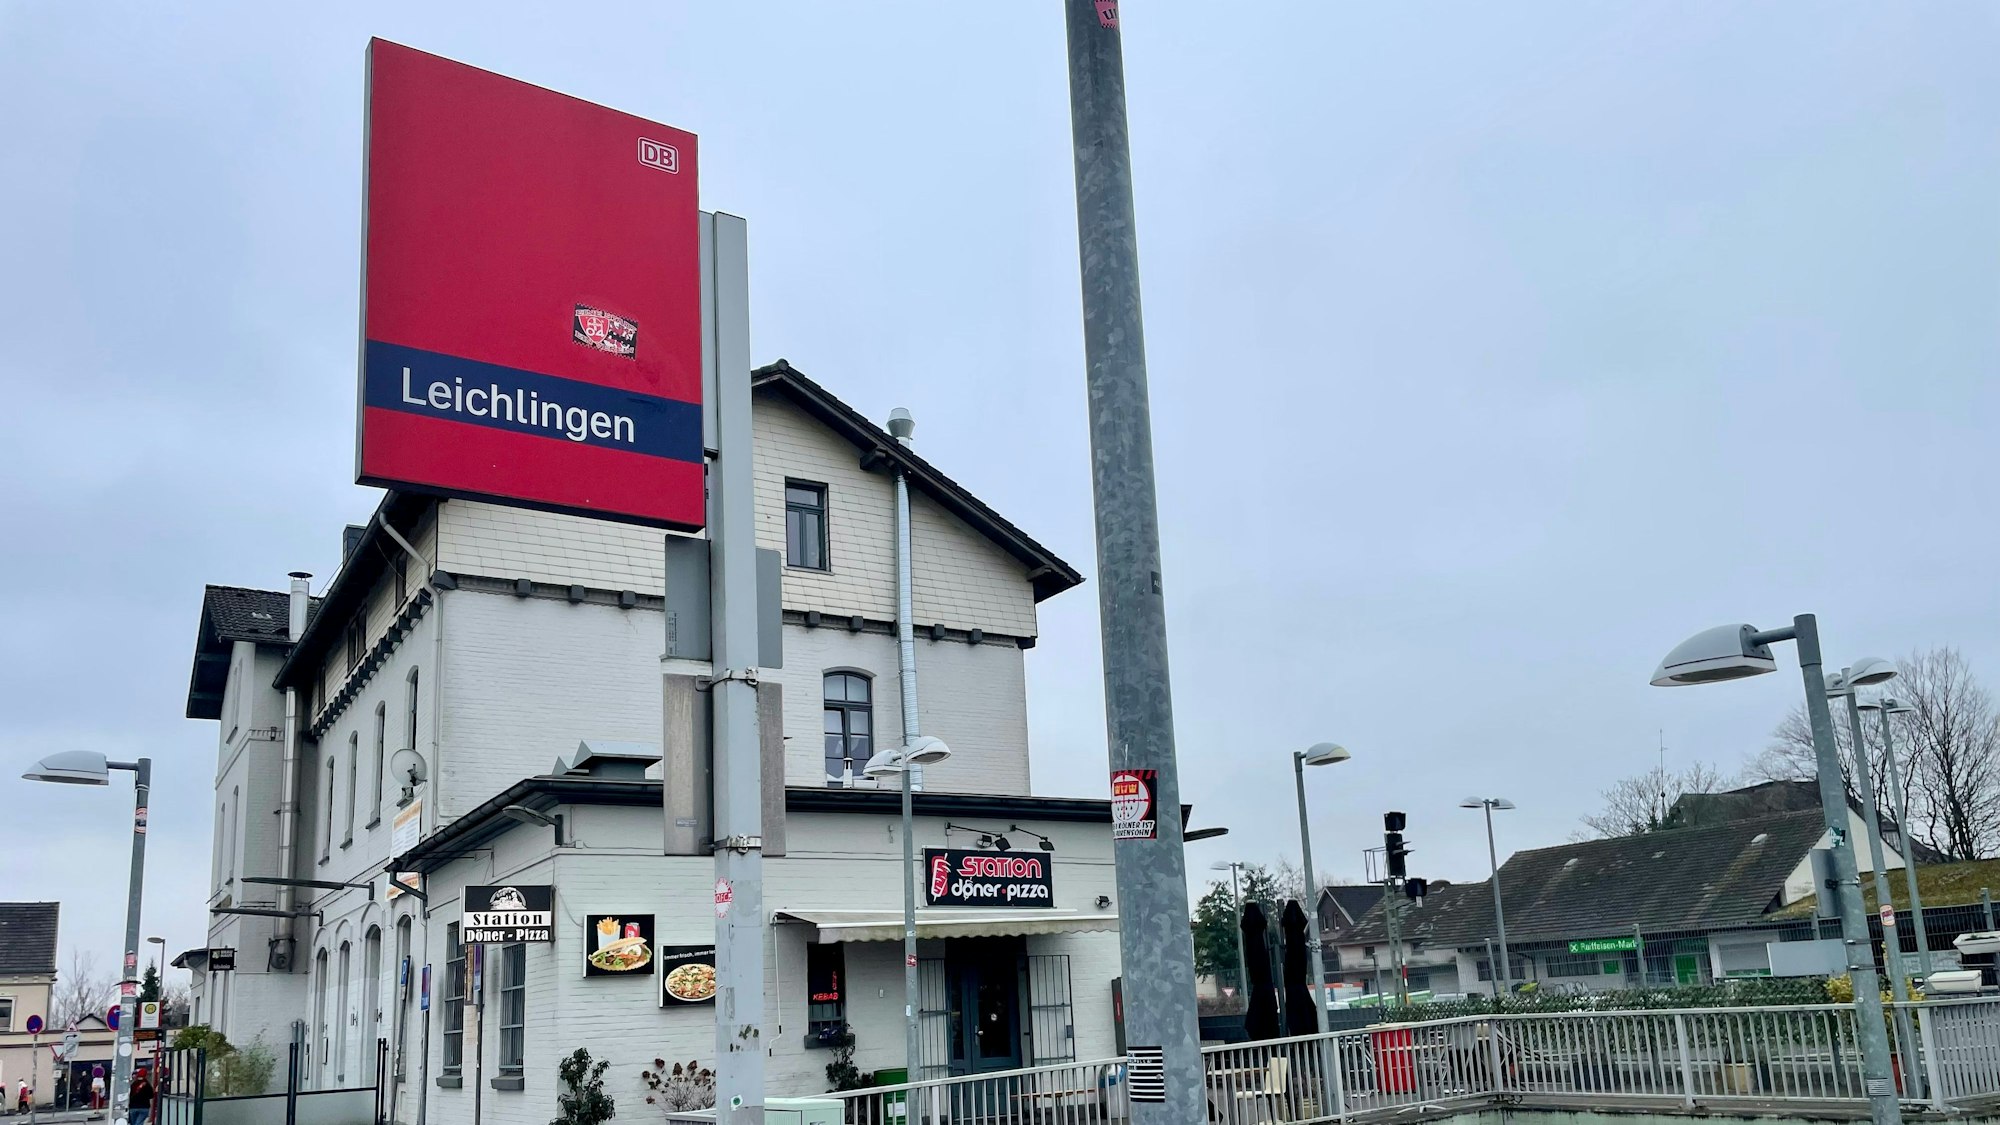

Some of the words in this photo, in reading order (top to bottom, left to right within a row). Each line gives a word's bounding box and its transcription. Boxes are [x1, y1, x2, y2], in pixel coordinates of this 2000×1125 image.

[643, 142, 674, 168] DB
[400, 366, 636, 444] Leichlingen
[1006, 883, 1049, 902] pizza
[473, 912, 543, 926] Station
[466, 928, 506, 943] Döner
[515, 927, 549, 941] Pizza
[1580, 939, 1637, 951] Raiffeisen-Mark
[812, 991, 839, 1001] KEBAB
